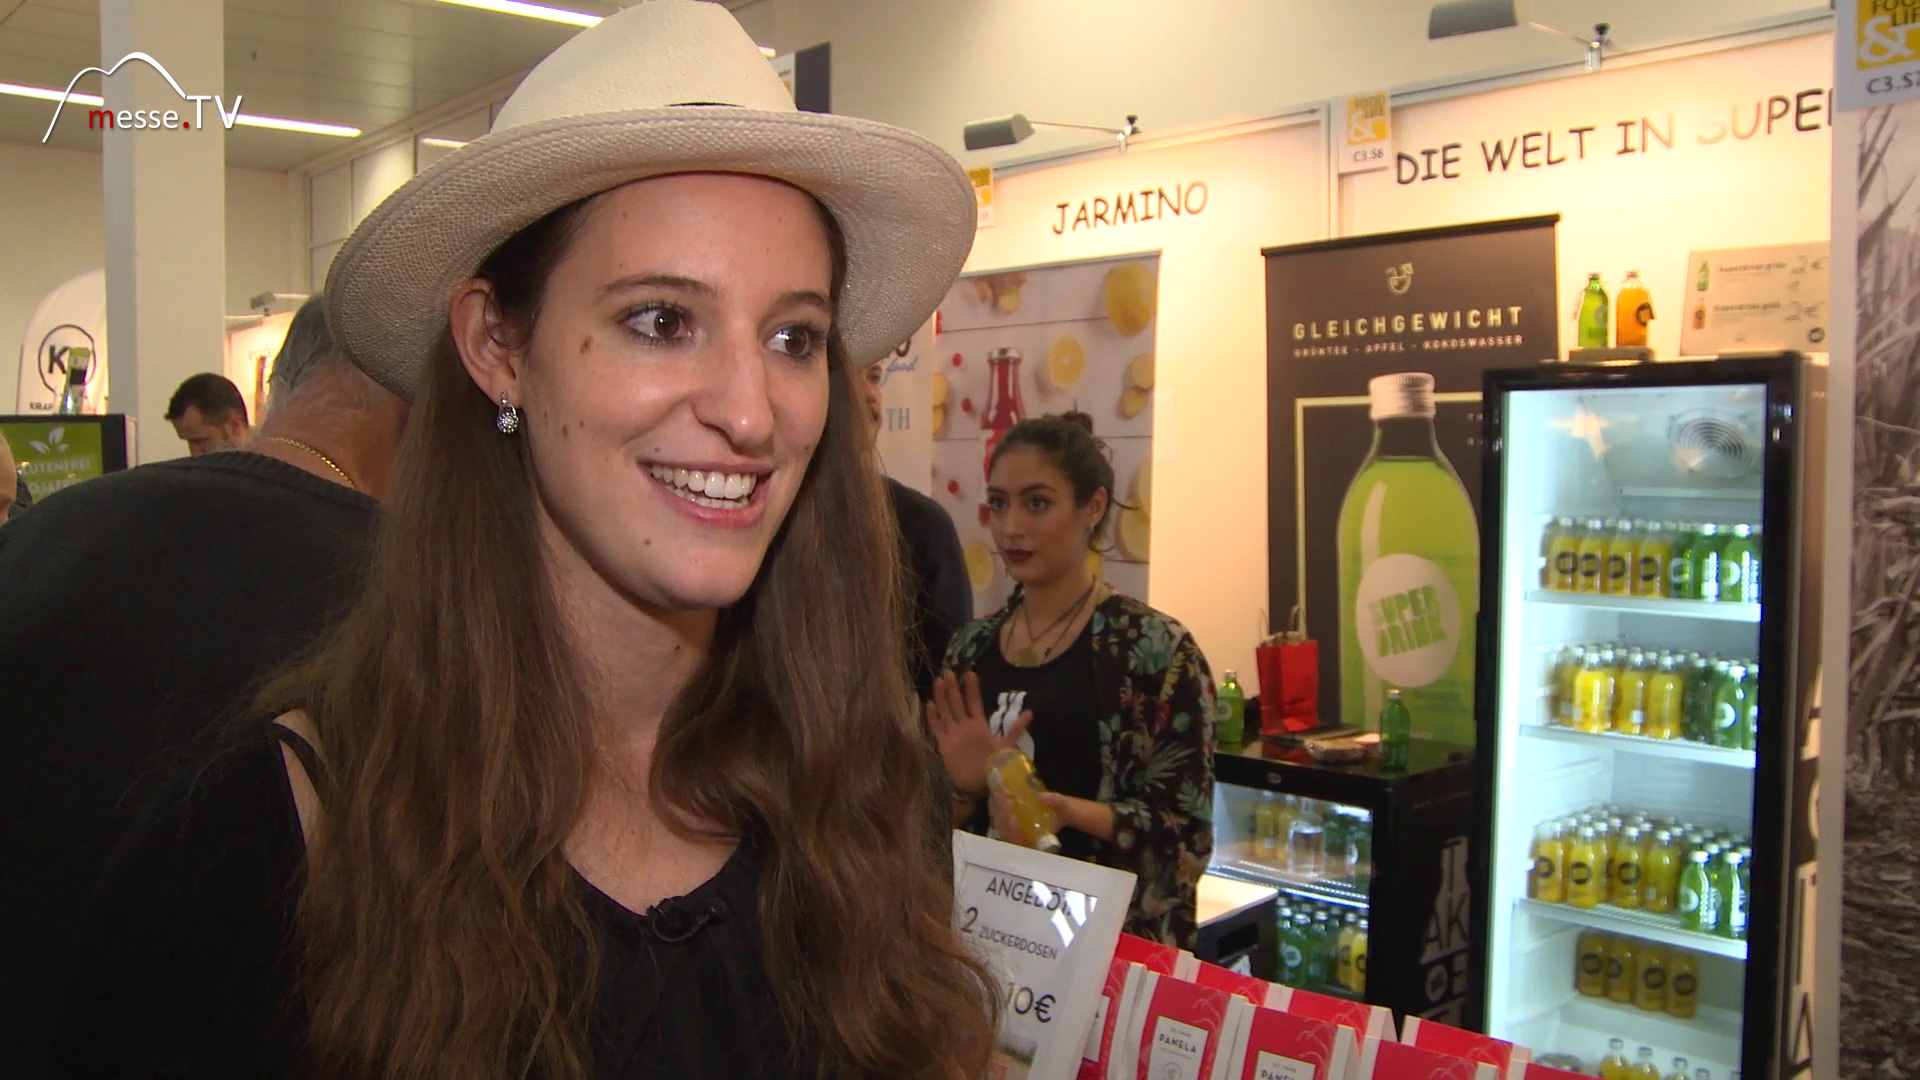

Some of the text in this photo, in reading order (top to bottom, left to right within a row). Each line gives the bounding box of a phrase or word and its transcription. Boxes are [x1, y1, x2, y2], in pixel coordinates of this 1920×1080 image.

[1397, 143, 1463, 185] DIE
[1480, 125, 1597, 173] WELT
[1616, 114, 1674, 155] IN
[1052, 180, 1209, 235] JARMINO
[1292, 306, 1522, 340] GLEICHGEWICHT
[1364, 342, 1405, 354] APFEL
[1422, 334, 1524, 350] KOKOSWASSER
[961, 906, 1059, 960] 2 ZUCKERDOSEN
[1158, 1033, 1197, 1054] PANELA
[1261, 1069, 1297, 1079] PANE
